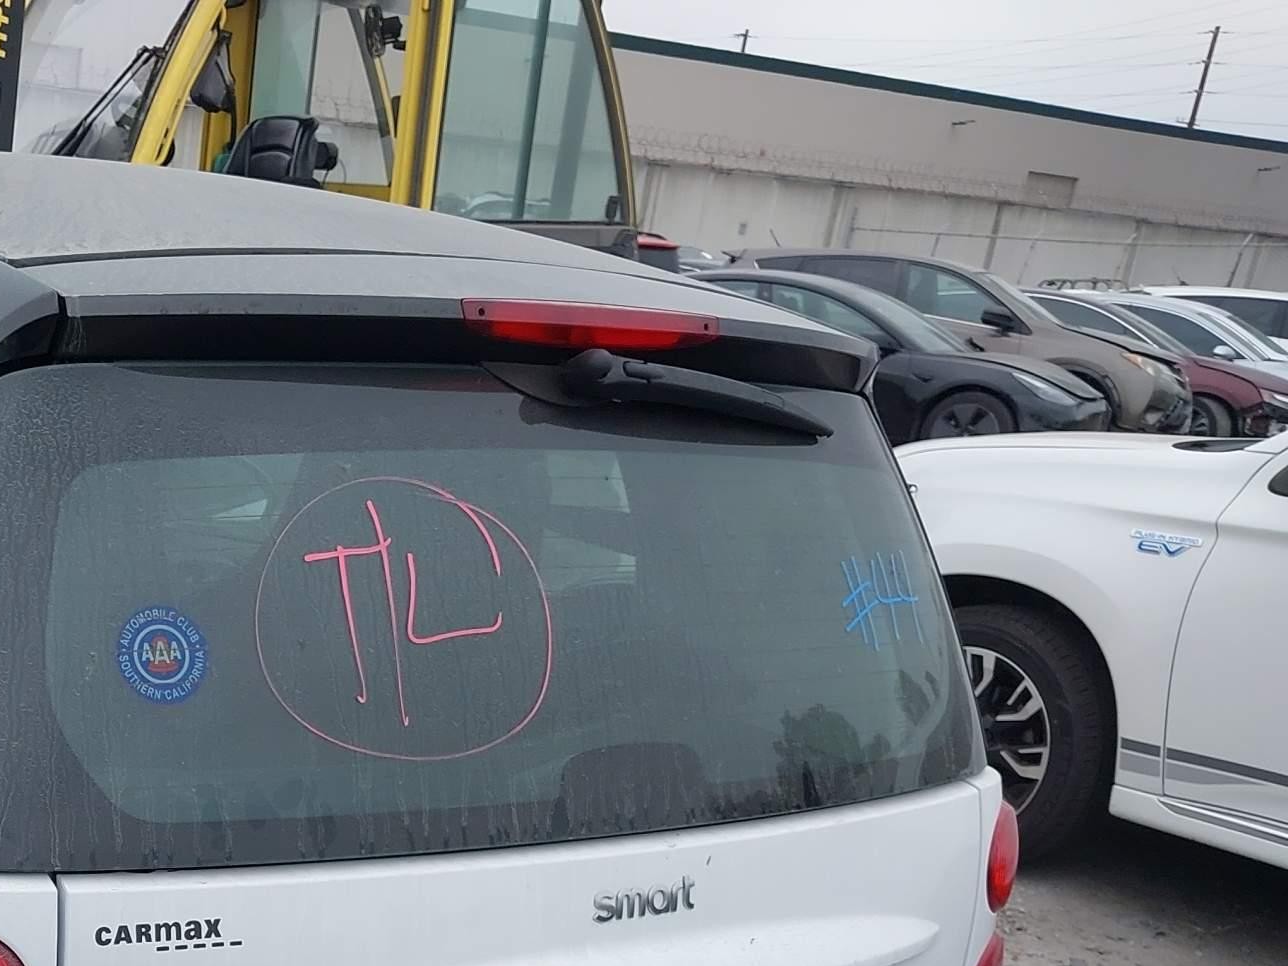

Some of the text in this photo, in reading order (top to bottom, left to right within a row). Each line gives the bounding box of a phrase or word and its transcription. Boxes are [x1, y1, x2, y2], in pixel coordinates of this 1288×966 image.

[1138, 540, 1188, 557] EV
[120, 608, 200, 647] AUTOMOBILE CLUB
[141, 640, 182, 665] AAA
[119, 650, 205, 701] SOUTHERN CALIFORNIA
[593, 875, 696, 924] smart
